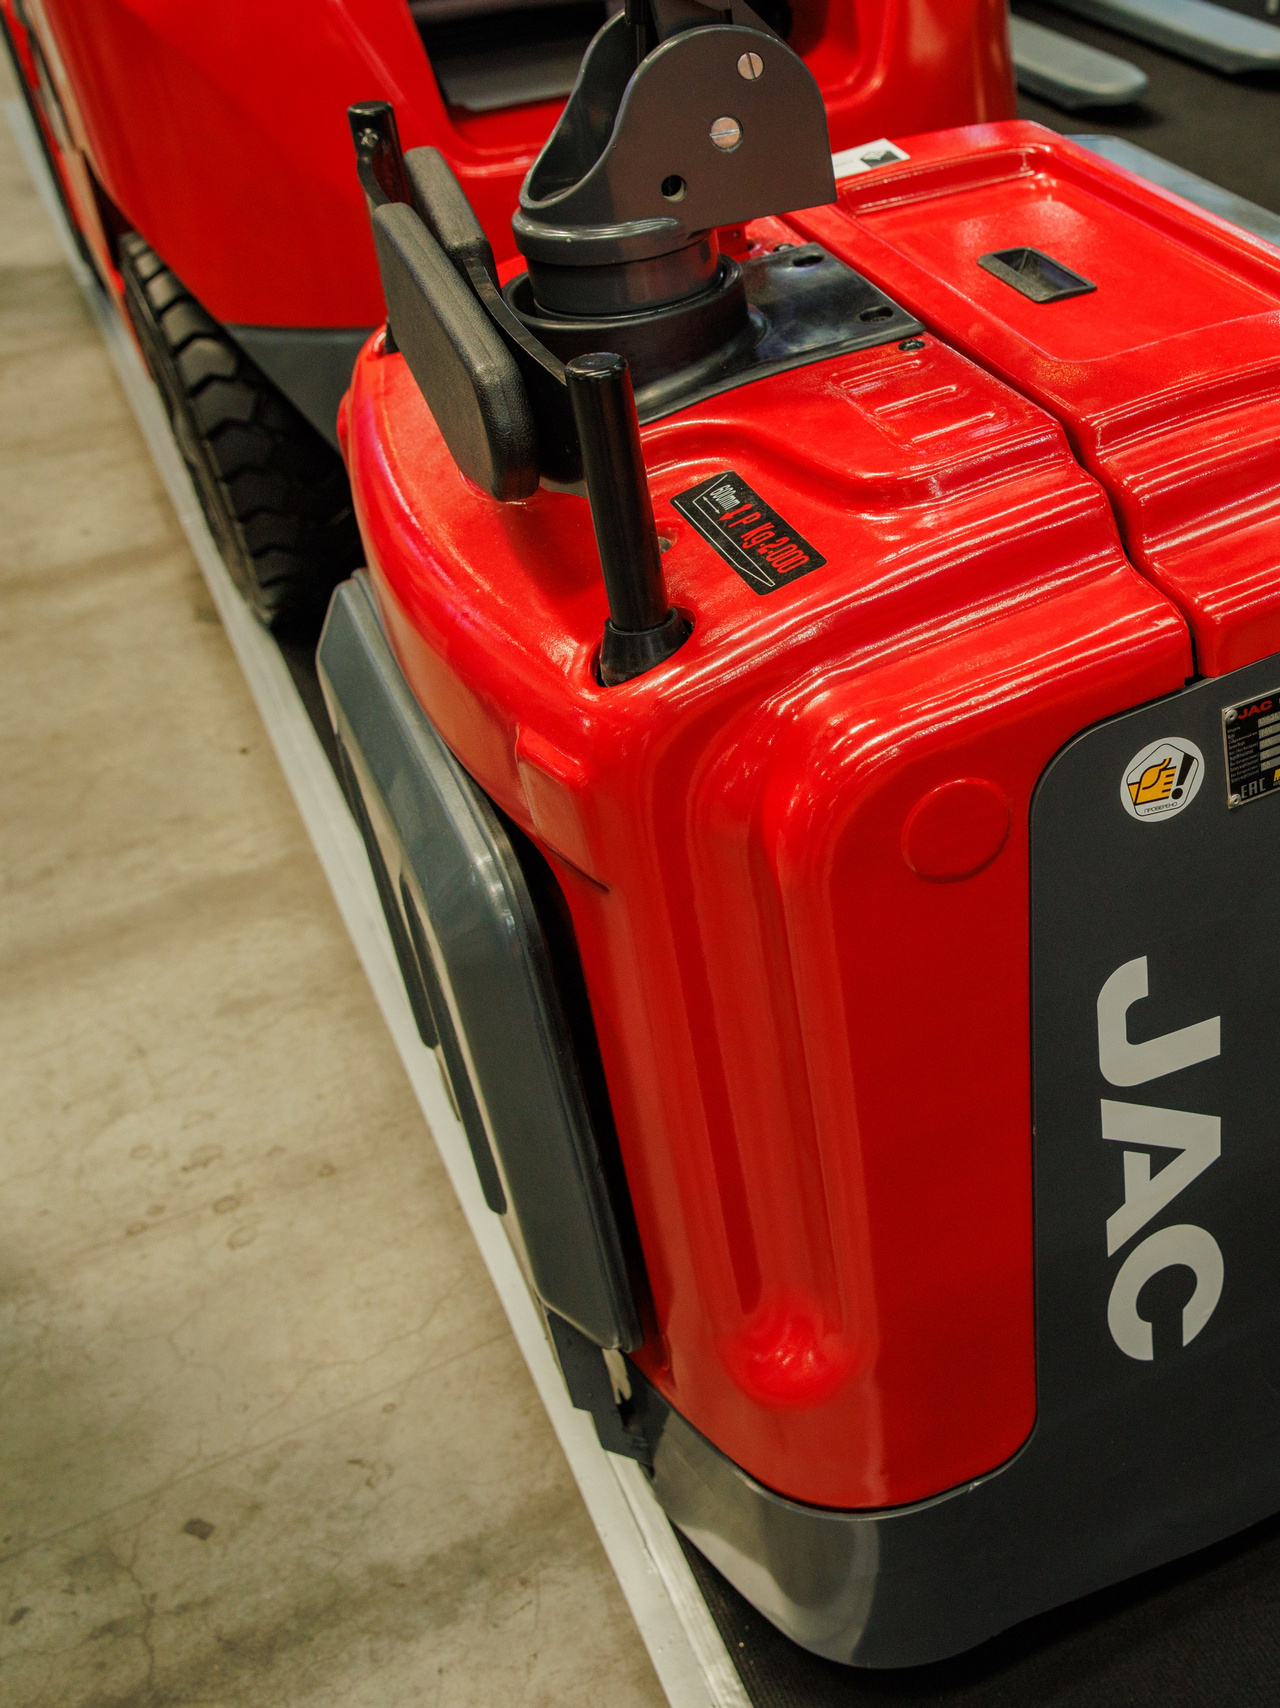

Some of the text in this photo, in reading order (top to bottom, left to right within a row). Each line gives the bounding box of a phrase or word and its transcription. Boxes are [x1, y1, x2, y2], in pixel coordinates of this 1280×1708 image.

[709, 484, 740, 510] 600mm
[728, 511, 761, 528] P
[1237, 700, 1272, 719] JAC
[1144, 802, 1178, 813] ПРОВЕРЕНО
[1097, 956, 1225, 1361] JAC
